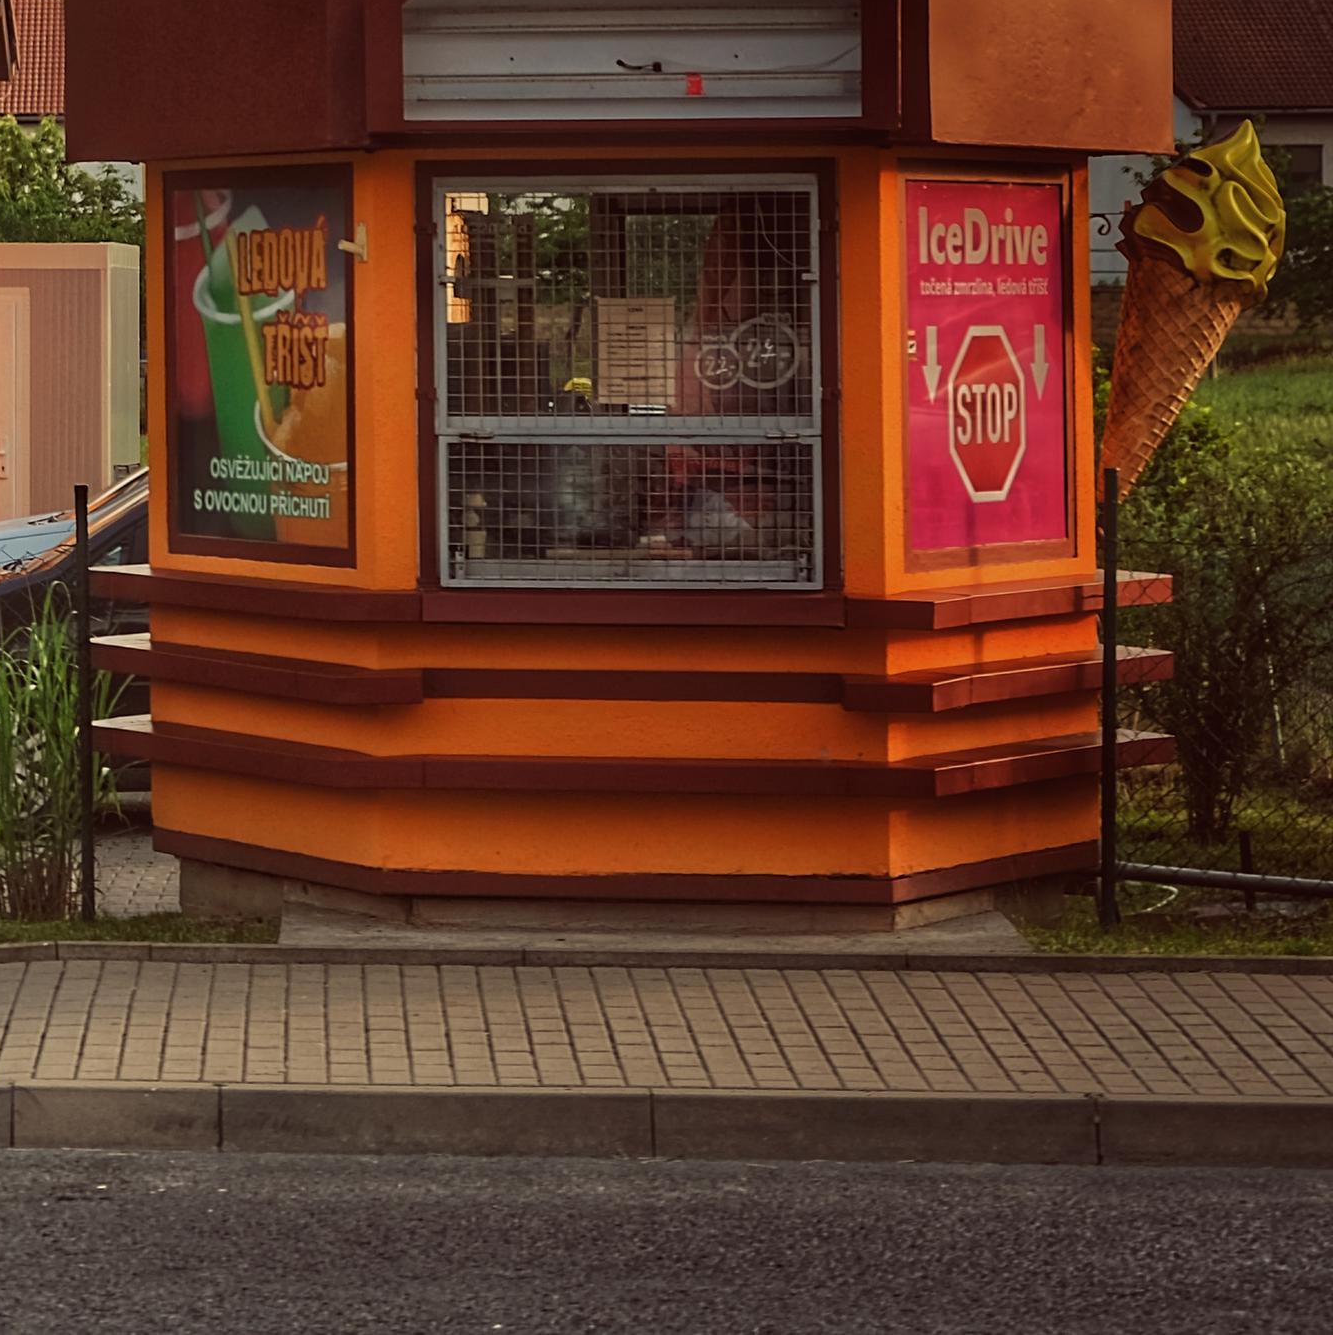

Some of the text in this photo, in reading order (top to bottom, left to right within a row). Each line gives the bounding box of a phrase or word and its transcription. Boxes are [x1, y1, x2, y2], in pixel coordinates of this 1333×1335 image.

[237, 216, 327, 296] LEDOVÁ
[918, 206, 1048, 265] IceDrive
[957, 382, 1018, 445] STOP
[210, 455, 283, 481] OSVĚŽUJÍCÍ
[193, 488, 330, 518] S OVOCNOU PŘÍCHUTÍ
